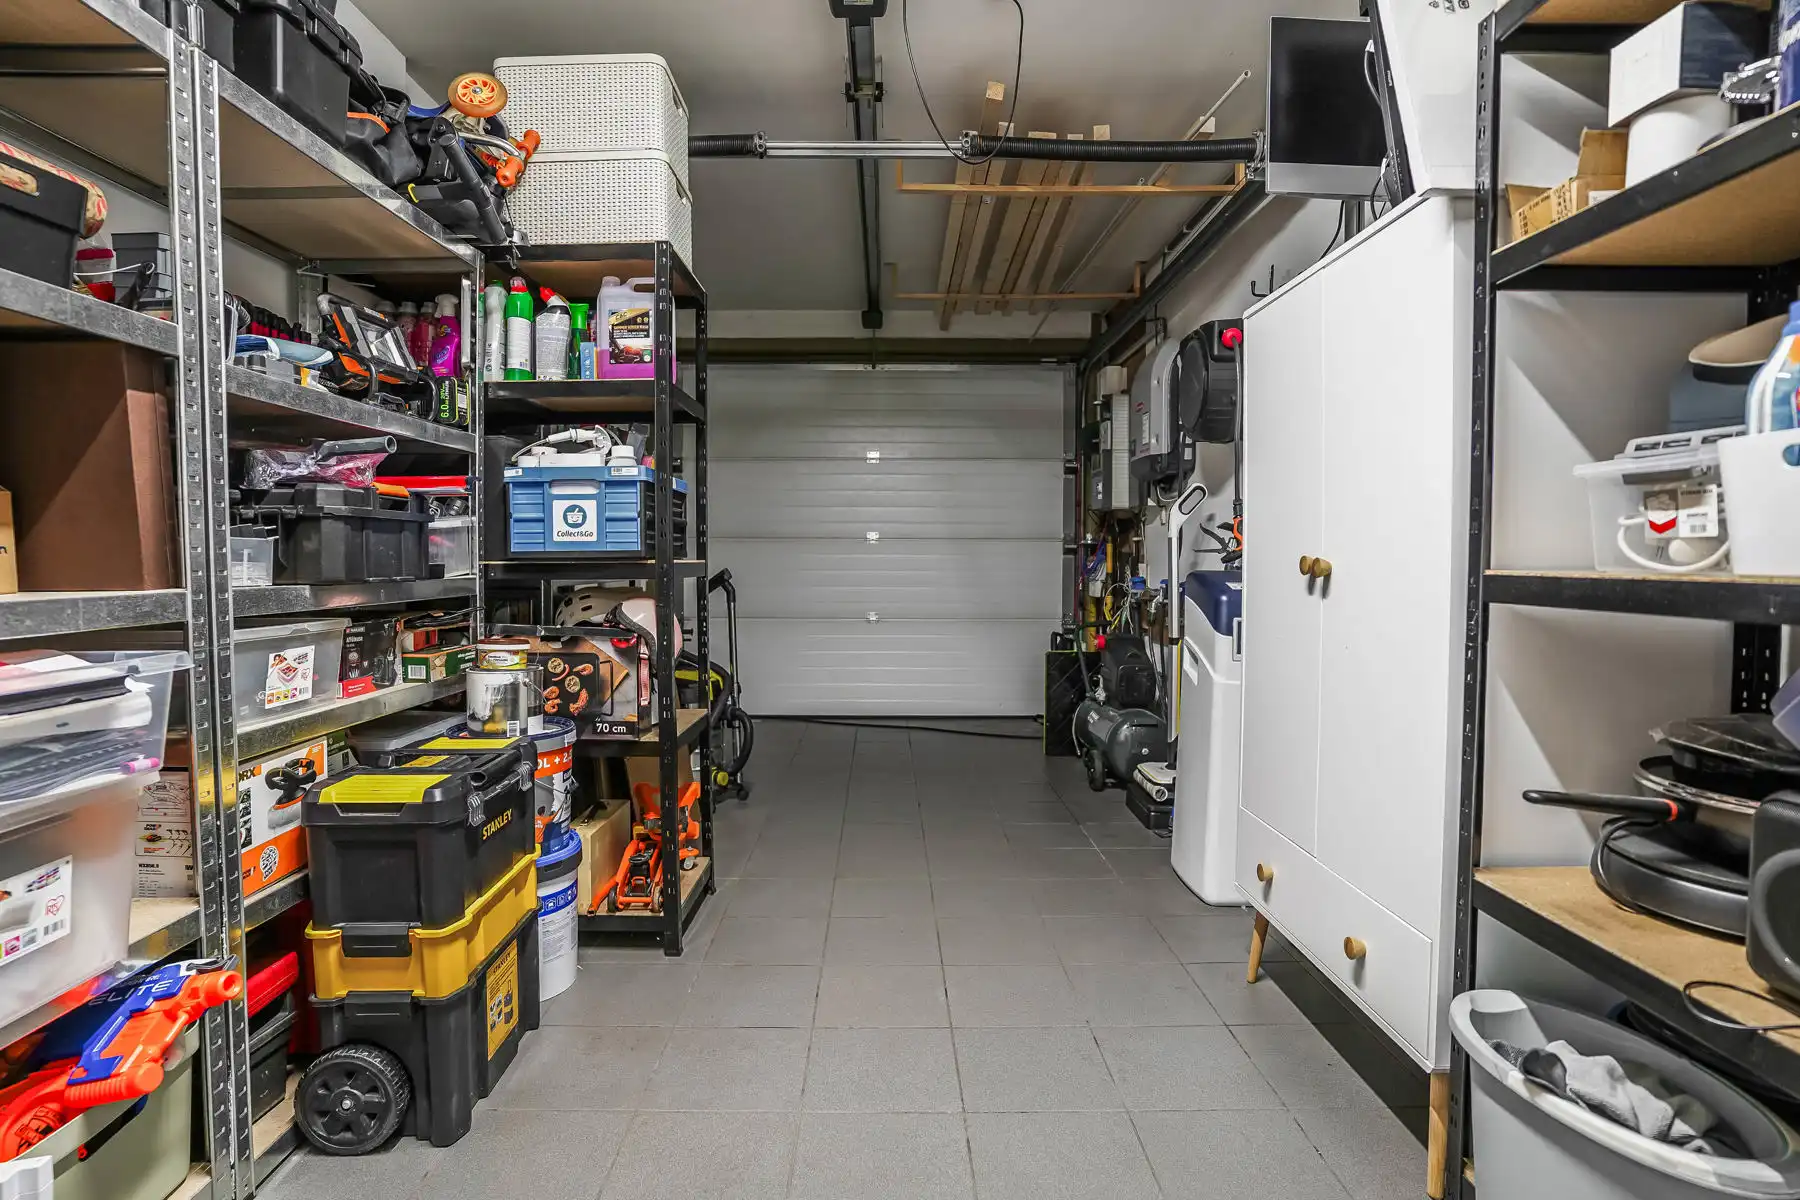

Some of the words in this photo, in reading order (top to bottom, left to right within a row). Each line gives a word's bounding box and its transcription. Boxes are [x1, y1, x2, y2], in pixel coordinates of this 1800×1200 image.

[596, 723, 610, 733] 70
[482, 808, 512, 841] STANLEY
[87, 979, 174, 1006] ELITE
